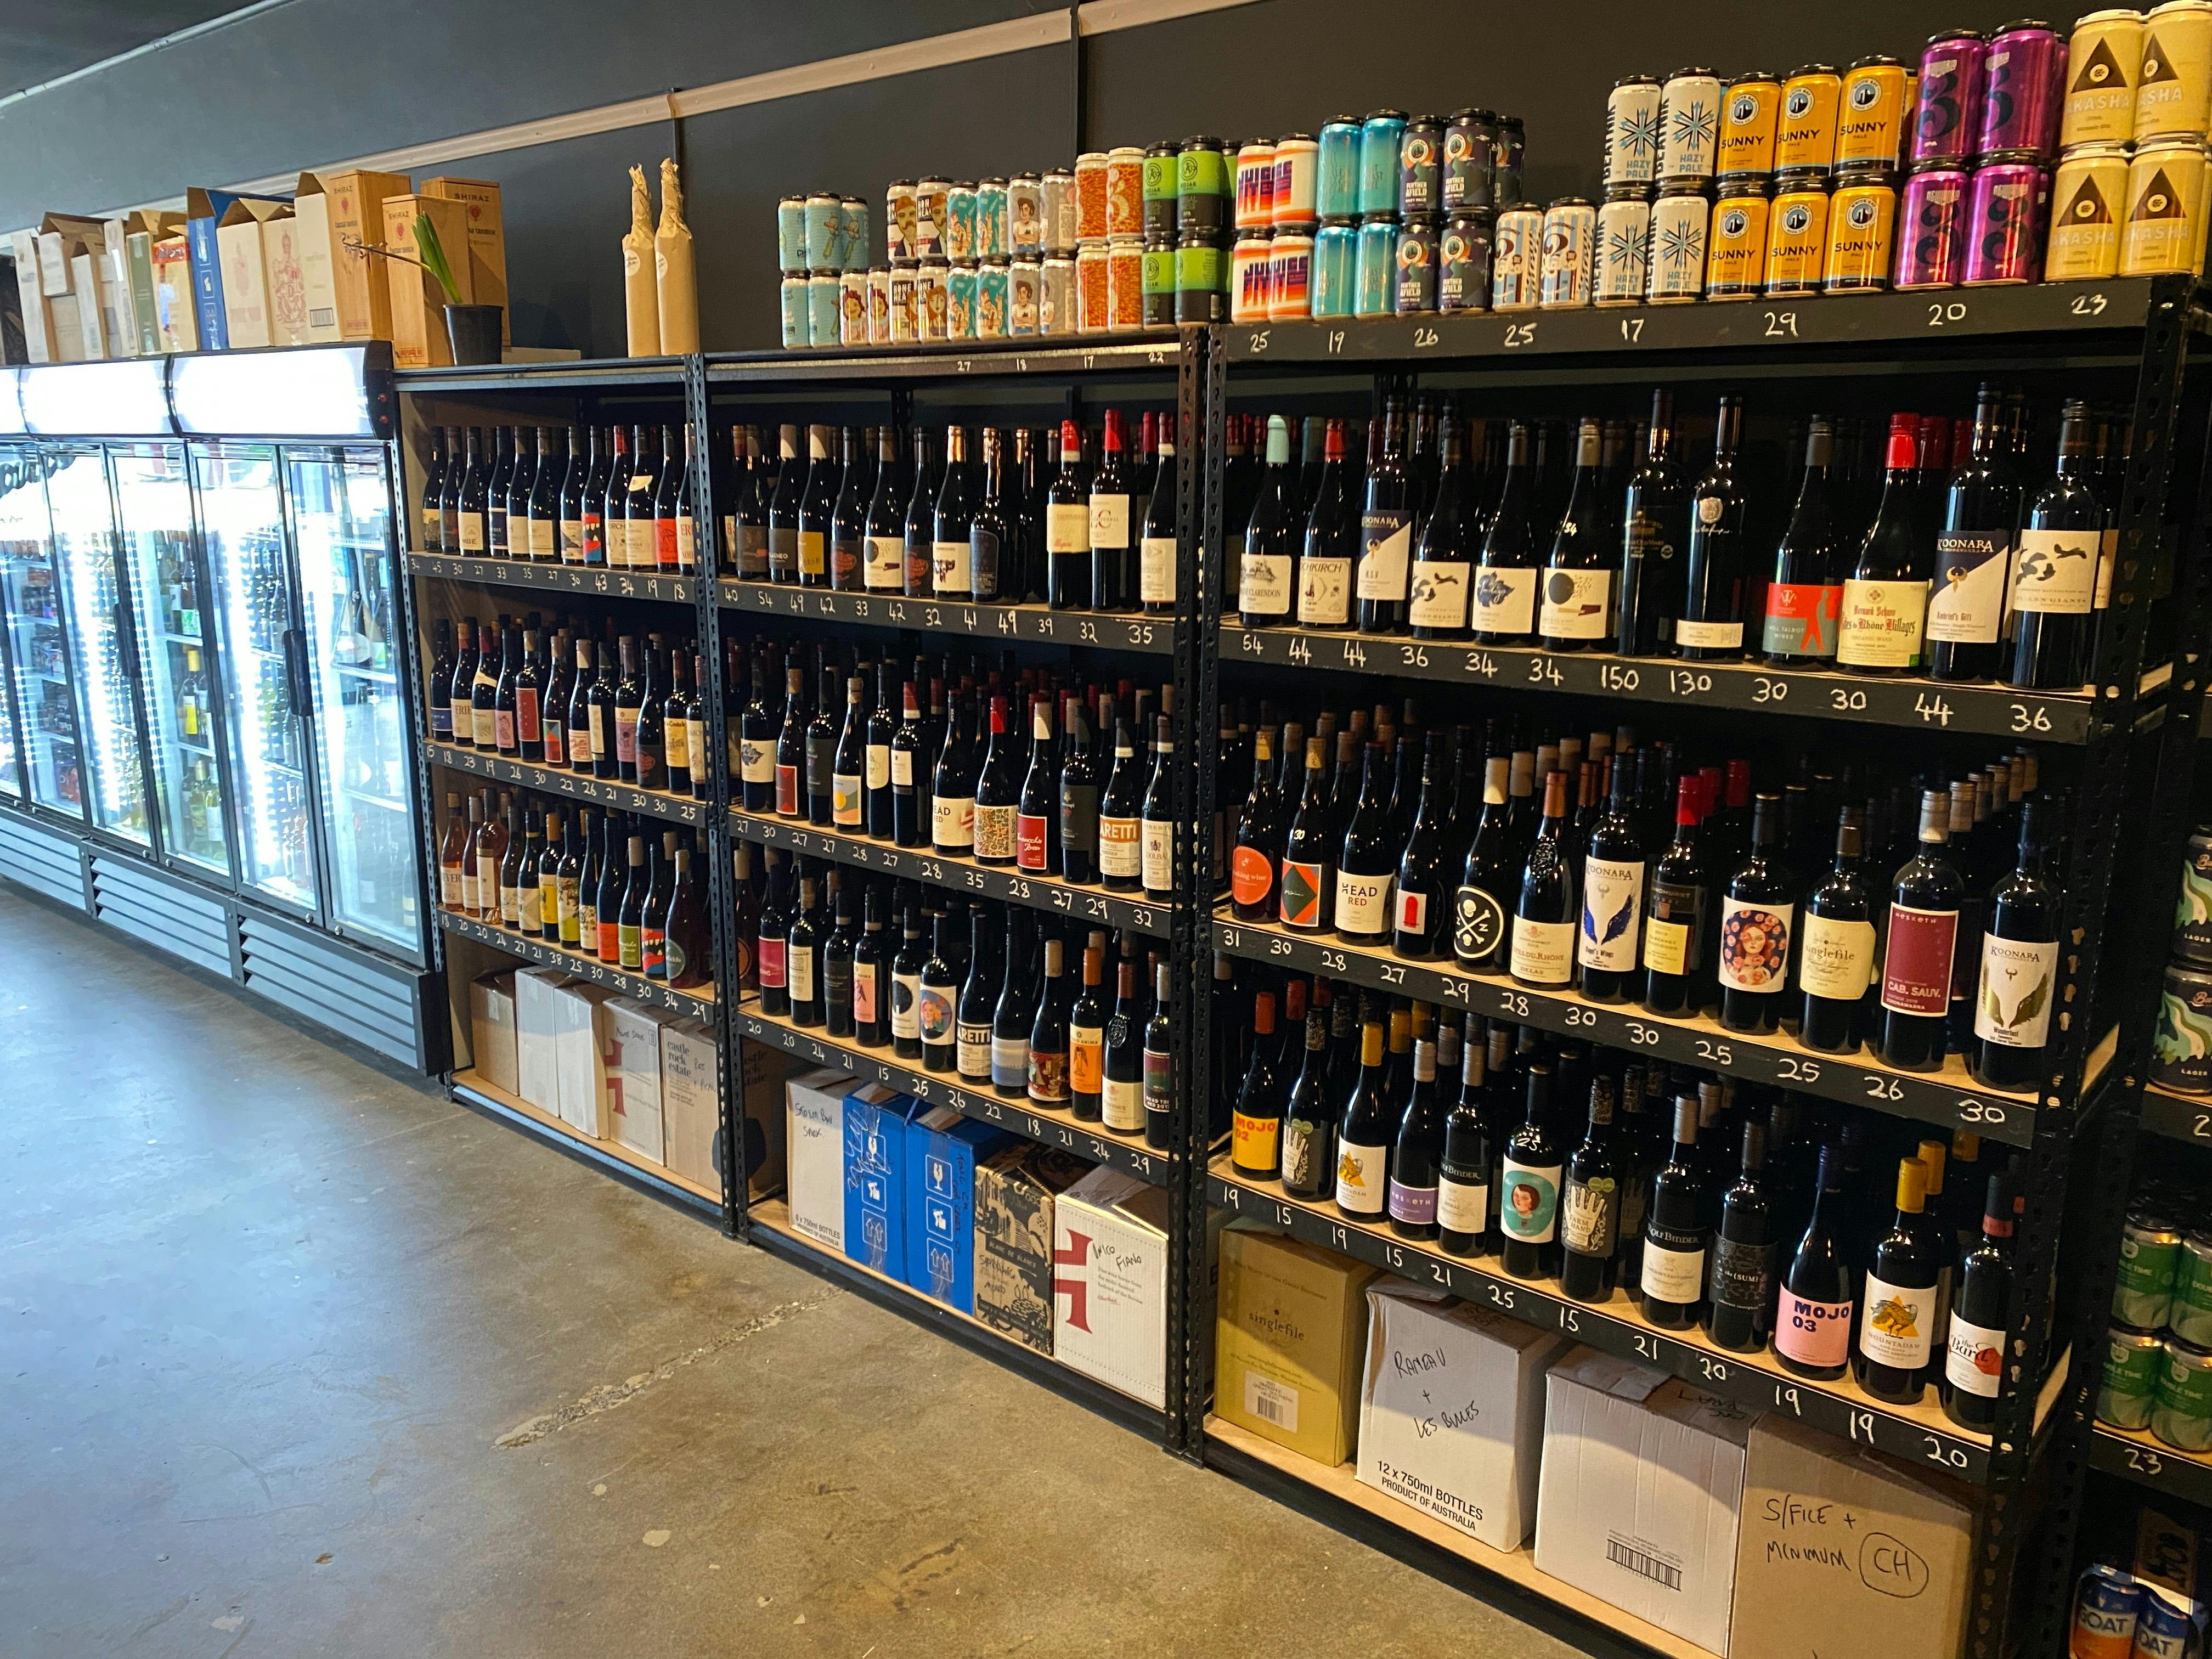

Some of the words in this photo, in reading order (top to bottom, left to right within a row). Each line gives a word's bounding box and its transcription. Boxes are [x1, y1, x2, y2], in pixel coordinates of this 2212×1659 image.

[1778, 129, 1821, 144] SUNNY
[1840, 122, 1887, 136] SUNNY
[1721, 136, 1765, 149] SUNNY
[1627, 160, 1651, 169] HAZY
[1680, 154, 1705, 162] HAZY
[1626, 170, 1649, 178] PALE
[1679, 163, 1702, 173] PALE
[454, 193, 490, 202] SHIRAZ
[1771, 246, 1818, 257] SUNNY
[1835, 241, 1883, 252] SUNNY
[1712, 250, 1756, 261] SUNNY
[1928, 303, 1966, 326] 20
[1764, 312, 1798, 337] 29
[1328, 331, 1344, 354] 19
[1504, 322, 1538, 347] 25
[957, 361, 970, 373] 27
[1084, 355, 1094, 369] 17
[1937, 539, 1994, 553] KOONARA
[571, 574, 580, 586] 30
[595, 578, 607, 595] 43
[648, 578, 658, 597] 19
[725, 588, 738, 602] 40
[758, 591, 772, 607] 54
[998, 610, 1017, 635] 49
[1039, 618, 1053, 636] 39
[1128, 624, 1153, 645] 35
[1289, 637, 1312, 665] 44
[1344, 640, 1367, 668] 44
[1465, 652, 1498, 679] 34
[1600, 665, 1639, 691] 150
[1752, 678, 1788, 703] 30
[1831, 688, 1867, 710] 30
[2011, 704, 2052, 732] 36
[511, 765, 522, 780] 26
[560, 777, 574, 793] 22
[584, 782, 597, 796] 26
[633, 793, 646, 807] 30
[681, 805, 696, 820] 25
[737, 821, 748, 833] 27
[792, 832, 808, 847] 27
[853, 847, 868, 862] 28
[922, 862, 942, 880] 28
[1586, 864, 1633, 881] KOONARA
[966, 871, 984, 889] 35
[1341, 882, 1378, 897] HEAD
[1051, 890, 1073, 911] 27
[1348, 896, 1367, 906] RED
[458, 919, 469, 931] 20
[1133, 909, 1152, 928] 32
[475, 926, 487, 939] 20
[1224, 929, 1239, 947] 31
[2184, 934, 2210, 943] LAGER
[549, 952, 562, 966] 38
[1322, 951, 1347, 972] 28
[1990, 946, 2040, 962] KOONARA
[591, 966, 603, 980] 30
[615, 974, 627, 989] 28
[1888, 981, 1909, 995] CAB.
[1911, 986, 1941, 998] SAUV.
[1442, 977, 1470, 1003] 29
[663, 991, 679, 1011] 34
[1886, 998, 1925, 1010] COONAWARRA
[1565, 1007, 1596, 1026] 30
[748, 1021, 761, 1034] 20
[1626, 1023, 1659, 1045] 30
[668, 1040, 690, 1054] castle
[812, 1043, 825, 1060] 24
[668, 1053, 687, 1066] rock
[843, 1054, 853, 1070] 21
[668, 1063, 692, 1078] estate
[1777, 1058, 1820, 1083] 25
[2181, 1068, 2208, 1077] LAGER
[912, 1079, 929, 1097] 25
[985, 1103, 1002, 1120] 22
[1957, 1099, 2006, 1124] 30
[1028, 1118, 1041, 1136] 18
[1235, 1117, 1277, 1132] MOJO
[1236, 1128, 1249, 1142] 02
[1090, 1141, 1110, 1161] 24
[1516, 1137, 1538, 1152] 25
[1224, 1186, 1239, 1209] 19
[819, 1224, 841, 1240] BOTTLES
[1571, 1223, 1591, 1233] HAND
[819, 1234, 840, 1247] AUSTRALIA
[1333, 1229, 1347, 1250] 19
[1115, 1252, 1142, 1272] FIANO
[1386, 1252, 1403, 1268] 15
[1734, 1273, 1759, 1283] (SUM)
[1487, 1284, 1514, 1310] 25
[1794, 1300, 1849, 1321] MOJO
[1249, 1311, 1305, 1340] singlefile
[1792, 1318, 1818, 1333] 03
[1634, 1335, 1657, 1360] 21
[1868, 1331, 1921, 1349] MOUNTADAM
[1961, 1339, 1974, 1348] the
[1775, 1385, 1802, 1416] 19
[1414, 1417, 1438, 1440] LES
[1850, 1410, 1875, 1444] 19
[2124, 1447, 2163, 1475] 23
[1377, 1460, 1390, 1477] 12
[1391, 1469, 1398, 1479] x
[1401, 1471, 1433, 1497] 750ml
[1435, 1488, 1483, 1521] BOTTLES
[1381, 1476, 1419, 1502] PRODUCT
[1420, 1496, 1430, 1508] OF
[1431, 1500, 1476, 1531] AUSTRALIA
[1873, 1547, 1912, 1582] CH
